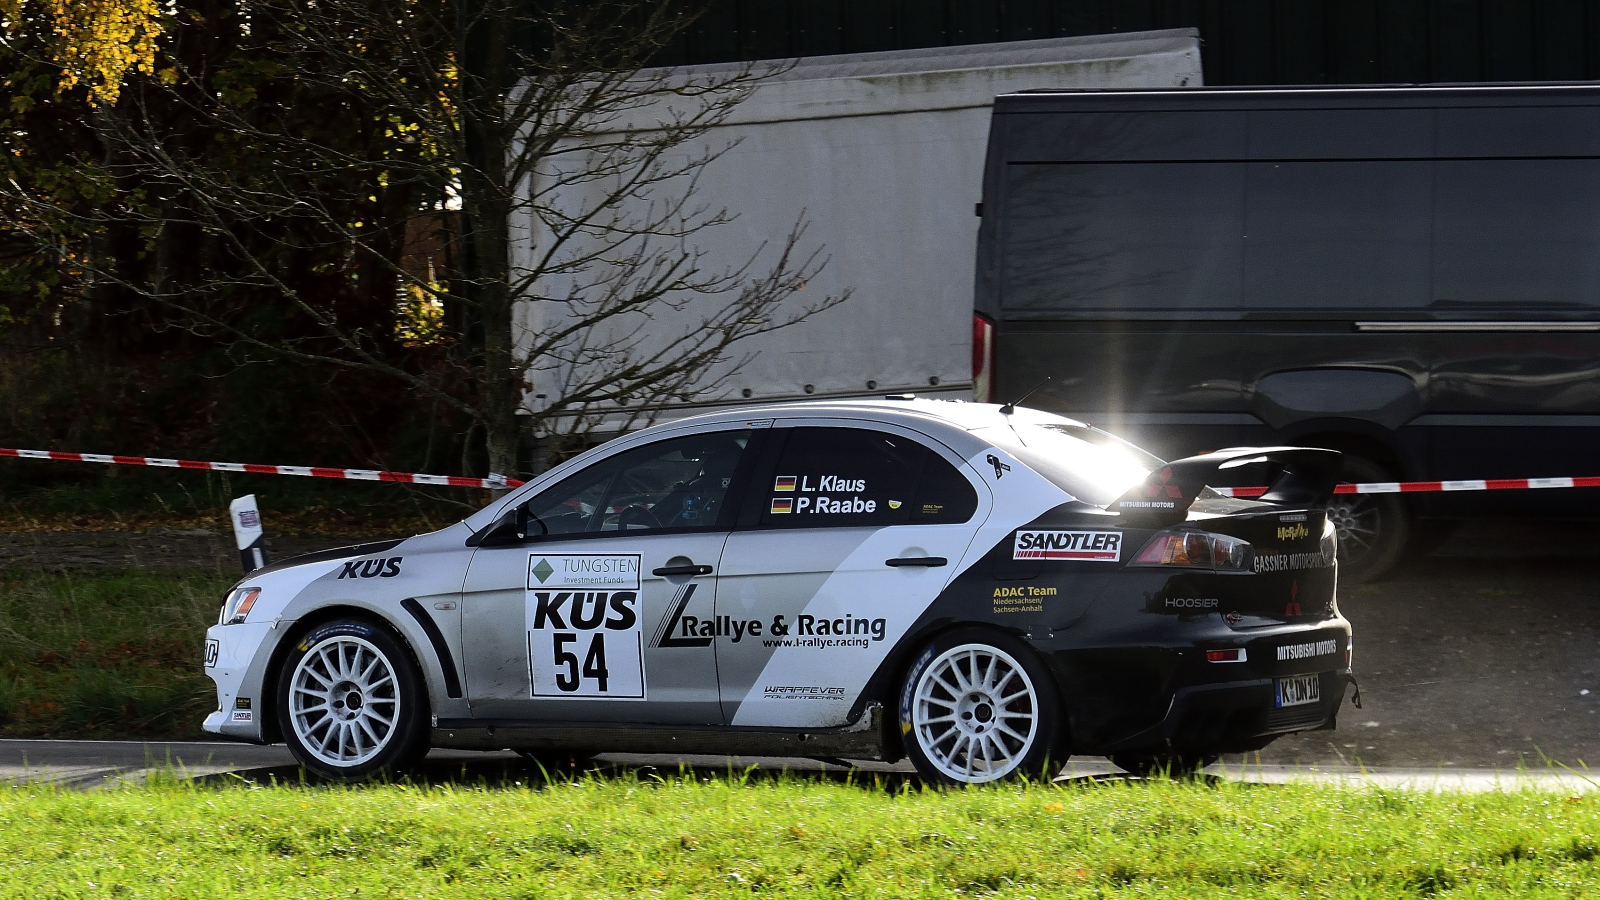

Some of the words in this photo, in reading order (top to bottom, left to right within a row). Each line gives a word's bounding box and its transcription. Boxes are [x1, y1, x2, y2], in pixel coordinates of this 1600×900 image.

[801, 475, 816, 492] L.
[819, 475, 866, 492] Klaus
[1152, 501, 1174, 509] MOTORS
[1018, 532, 1120, 551] SANDTLER
[338, 556, 403, 579] KÜS
[563, 558, 637, 573] TUNGSTEN
[1253, 554, 1288, 573] GASSNER
[564, 576, 602, 584] Investment
[603, 576, 624, 584] Funds
[993, 587, 1025, 597] ADAC
[1027, 586, 1057, 596] Team
[533, 591, 637, 630] KÜS
[993, 605, 1043, 614] Sachsen-Anhalt
[1165, 598, 1218, 607] HOOSIER
[681, 615, 763, 643] Rallye
[770, 614, 789, 636] &
[797, 614, 887, 641] Racing
[1277, 643, 1316, 660] MITSUBISHI
[1316, 639, 1336, 656] MOTORS
[553, 632, 609, 692] 54
